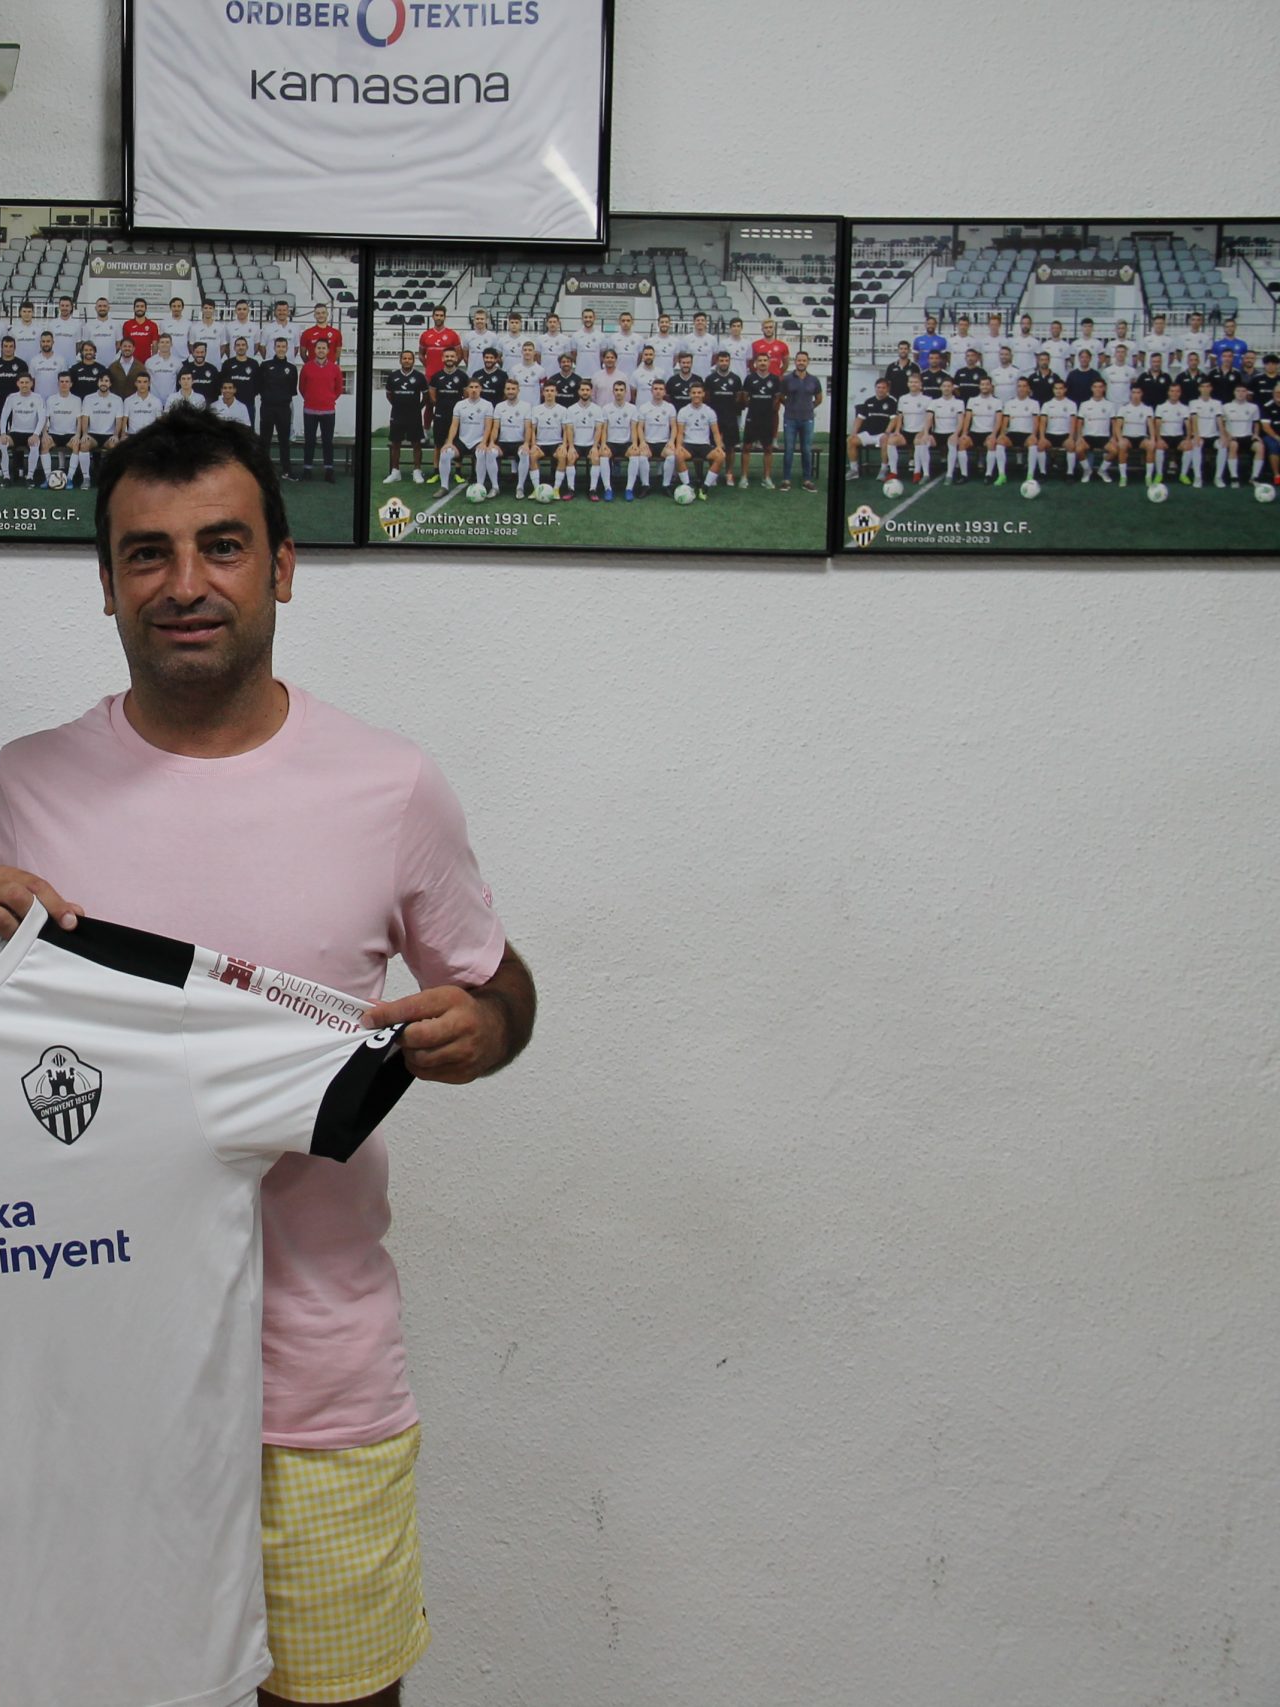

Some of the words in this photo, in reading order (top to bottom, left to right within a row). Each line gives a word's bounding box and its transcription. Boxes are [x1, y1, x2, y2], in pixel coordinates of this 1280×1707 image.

[225, 0, 349, 28] ORDIBER
[410, 0, 540, 28] TEXTILES
[13, 508, 47, 520] 1931
[51, 508, 80, 520] C.F.
[415, 512, 491, 527] Ontinyent
[495, 513, 528, 525] 1931
[532, 513, 561, 525] C.F.
[415, 527, 466, 535] Temporada
[468, 528, 518, 536] 2021-2022
[885, 520, 961, 534] Ontinyent
[965, 521, 998, 533] 1931
[1003, 521, 1032, 534] C.F.
[885, 535, 935, 543] Temporada
[937, 535, 991, 544] 2022-2023
[273, 971, 366, 1021] Ajuntamen
[266, 986, 361, 1034] Ontinyent
[40, 1099, 74, 1117] ONTINYENT
[75, 1095, 87, 1105] 1931
[87, 1092, 96, 1101] CF
